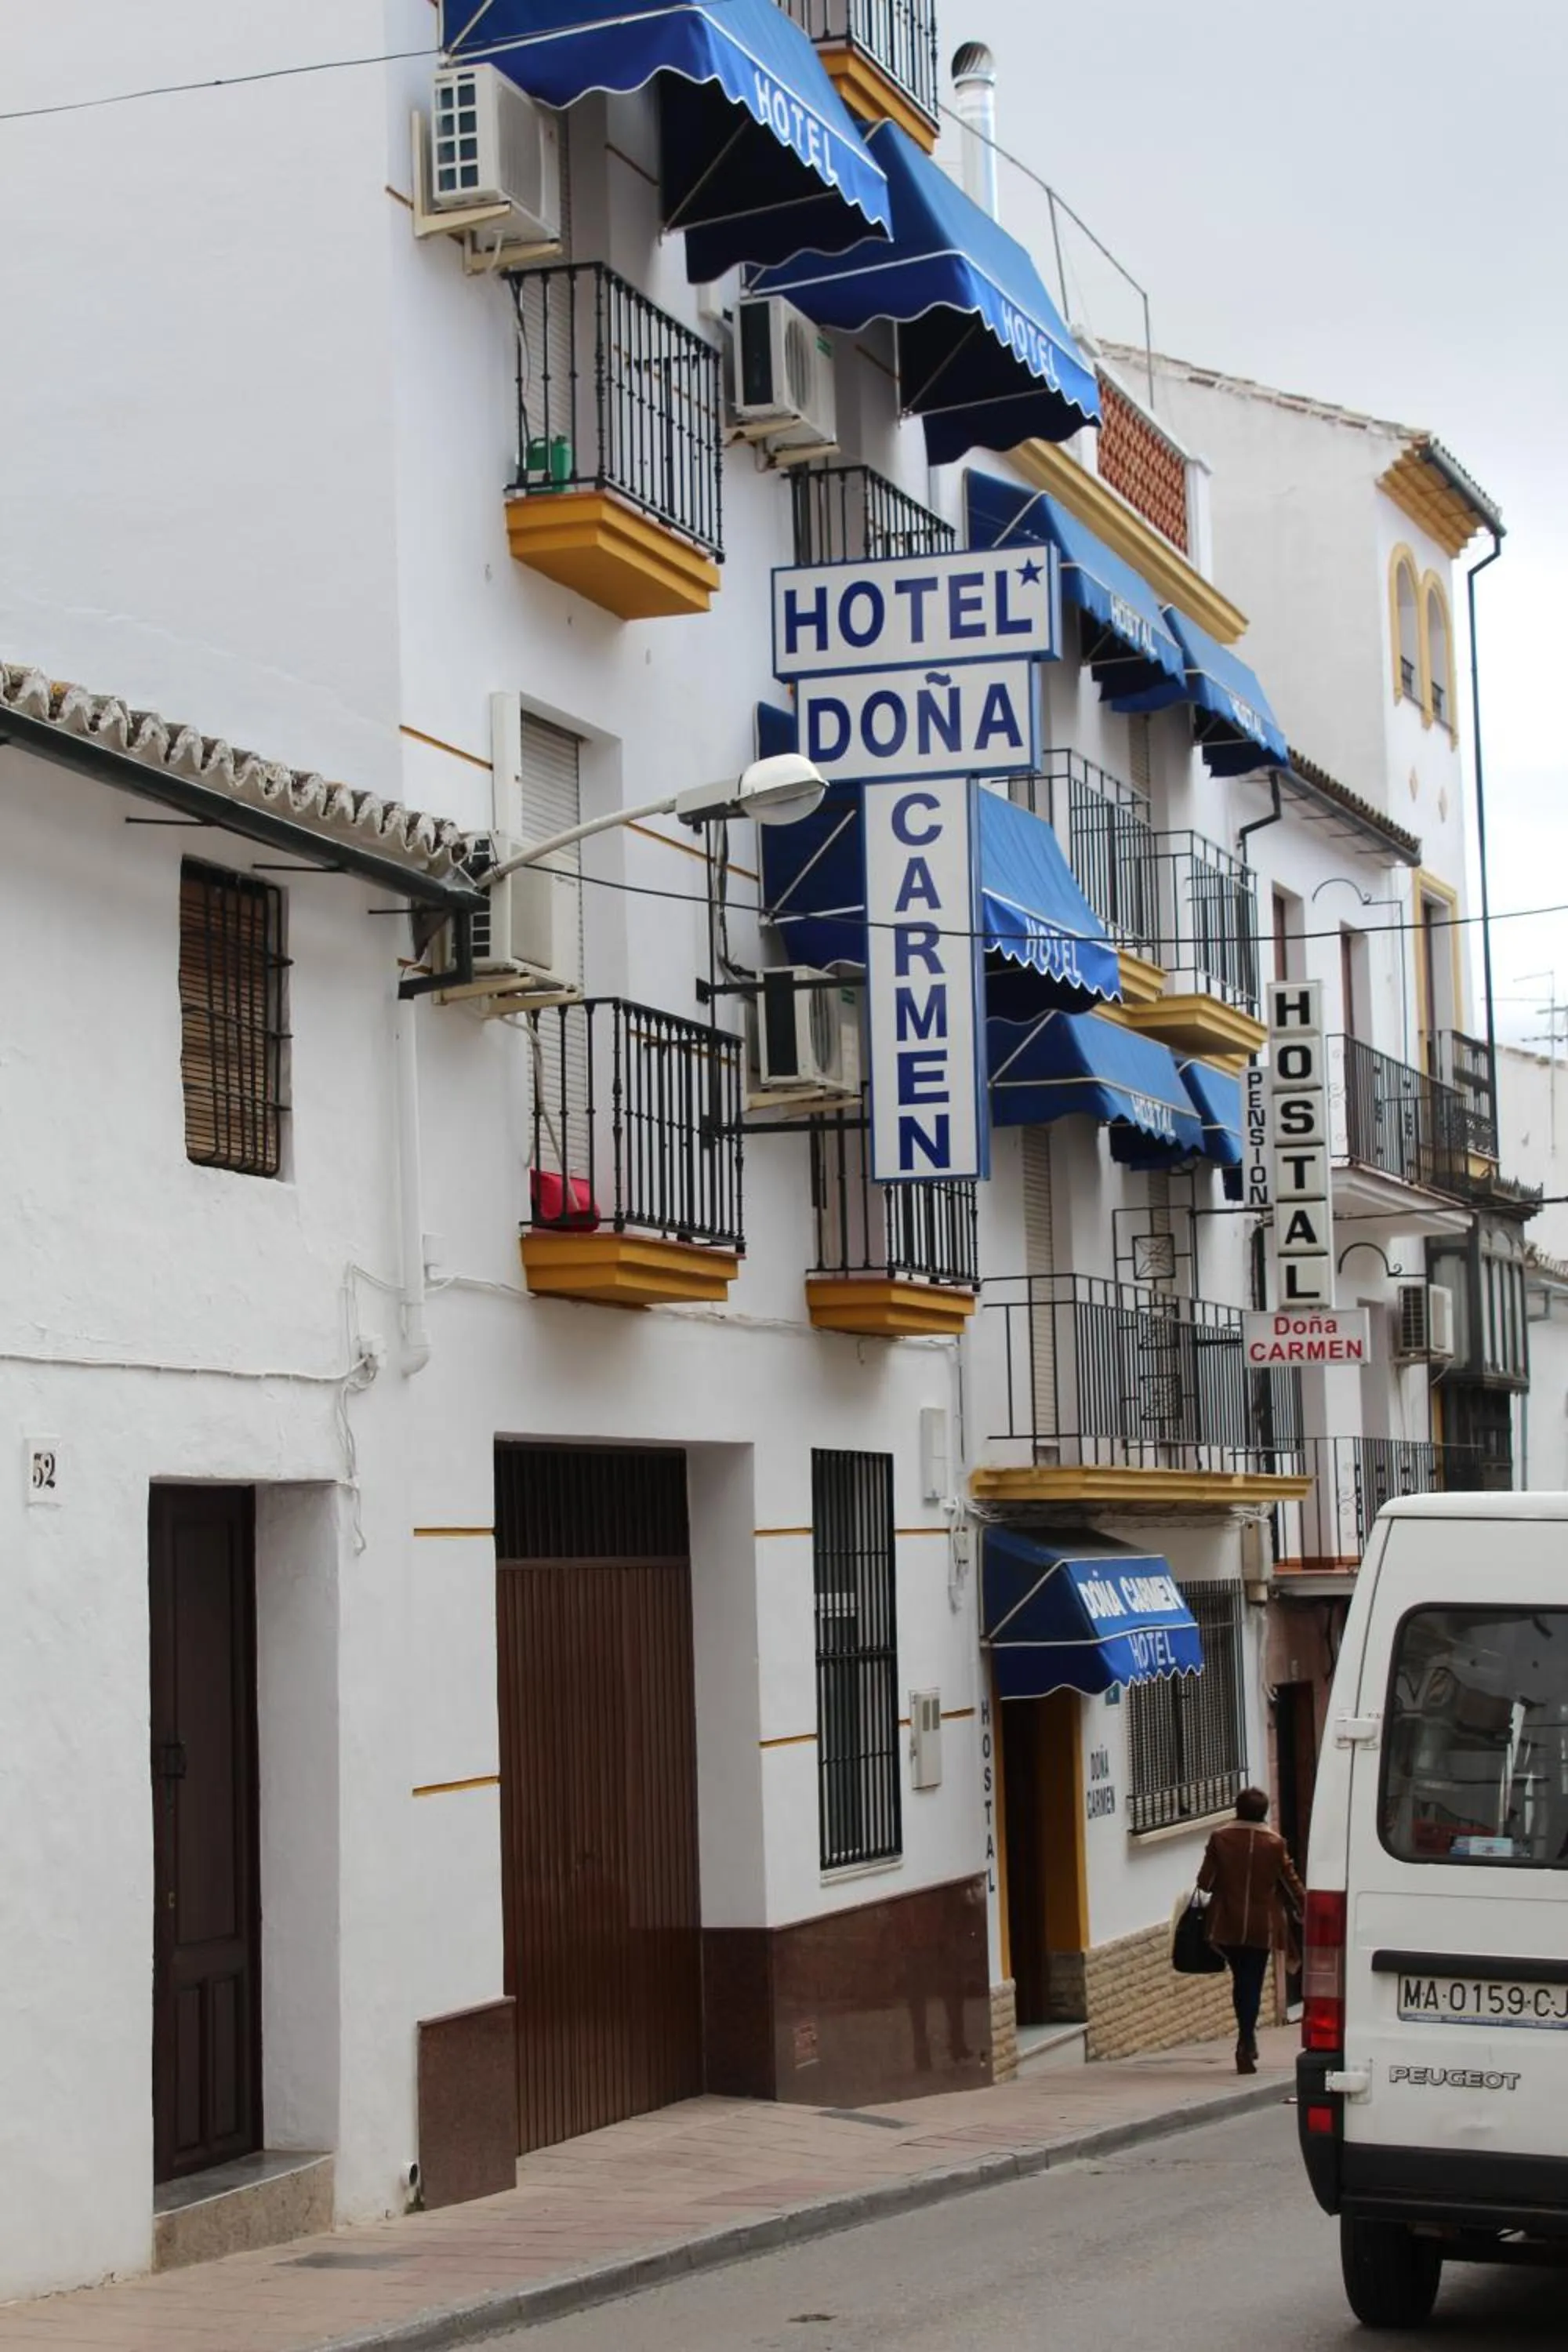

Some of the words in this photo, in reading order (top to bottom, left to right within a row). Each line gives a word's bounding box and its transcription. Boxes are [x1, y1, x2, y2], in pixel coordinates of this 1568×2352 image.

[753, 72, 837, 187] HOTEL
[1000, 299, 1061, 388] HOTEL
[785, 569, 1033, 655] HOTEL
[807, 670, 1024, 763] DOÑA
[891, 793, 951, 1171] CARMEN
[1025, 916, 1082, 978] HOTEL
[1247, 1071, 1268, 1206] PENSION
[1274, 990, 1320, 1300] HOSTAL
[1249, 1339, 1363, 1362] CARMEN
[1274, 1316, 1338, 1336] Doña
[1119, 1574, 1185, 1613] CARMEN
[1127, 1630, 1176, 1670] HOTEL
[981, 1700, 995, 1893] HOSTAL
[1389, 2064, 1522, 2091] PEUGEOT
